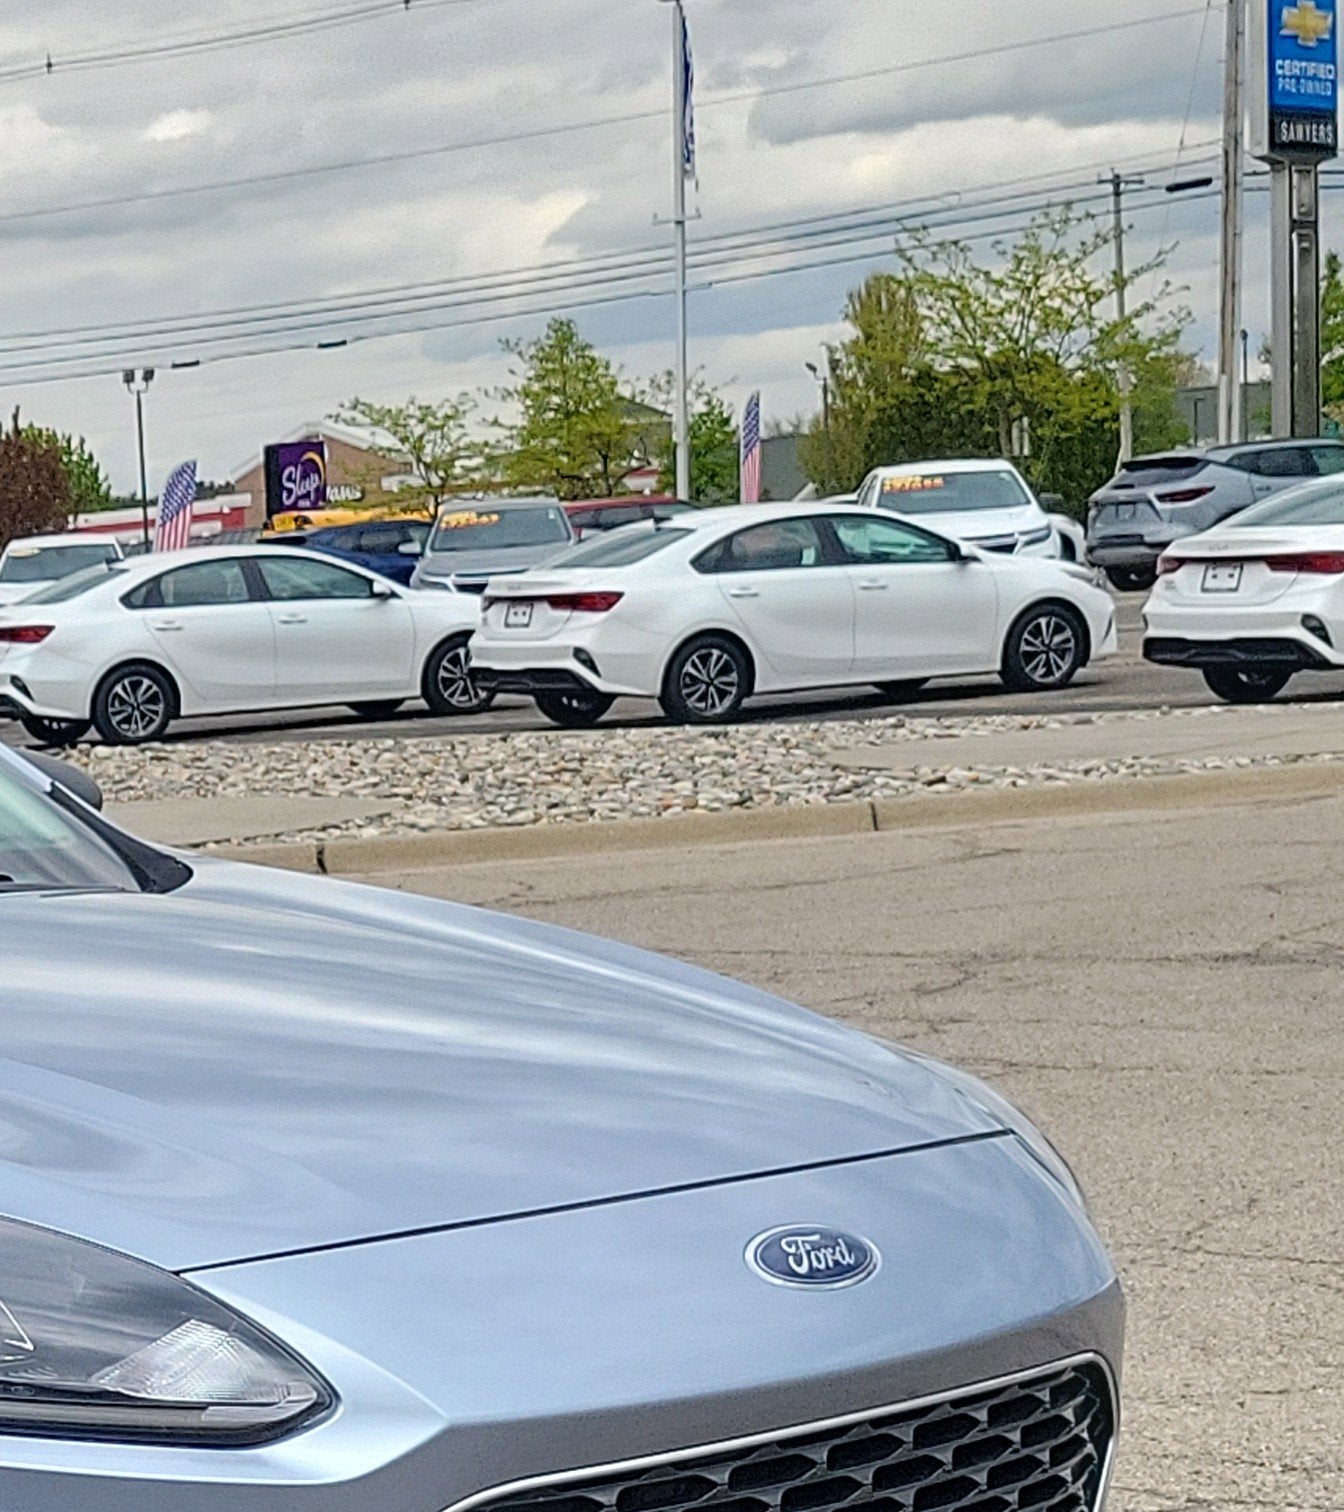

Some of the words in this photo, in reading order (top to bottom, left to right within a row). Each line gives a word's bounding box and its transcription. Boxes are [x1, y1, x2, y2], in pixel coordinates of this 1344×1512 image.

[1275, 59, 1335, 79] CERTIFIED
[1277, 77, 1332, 96] PRE-OWNED
[1280, 120, 1333, 143] SAWYERS
[780, 1233, 856, 1275] Ford
